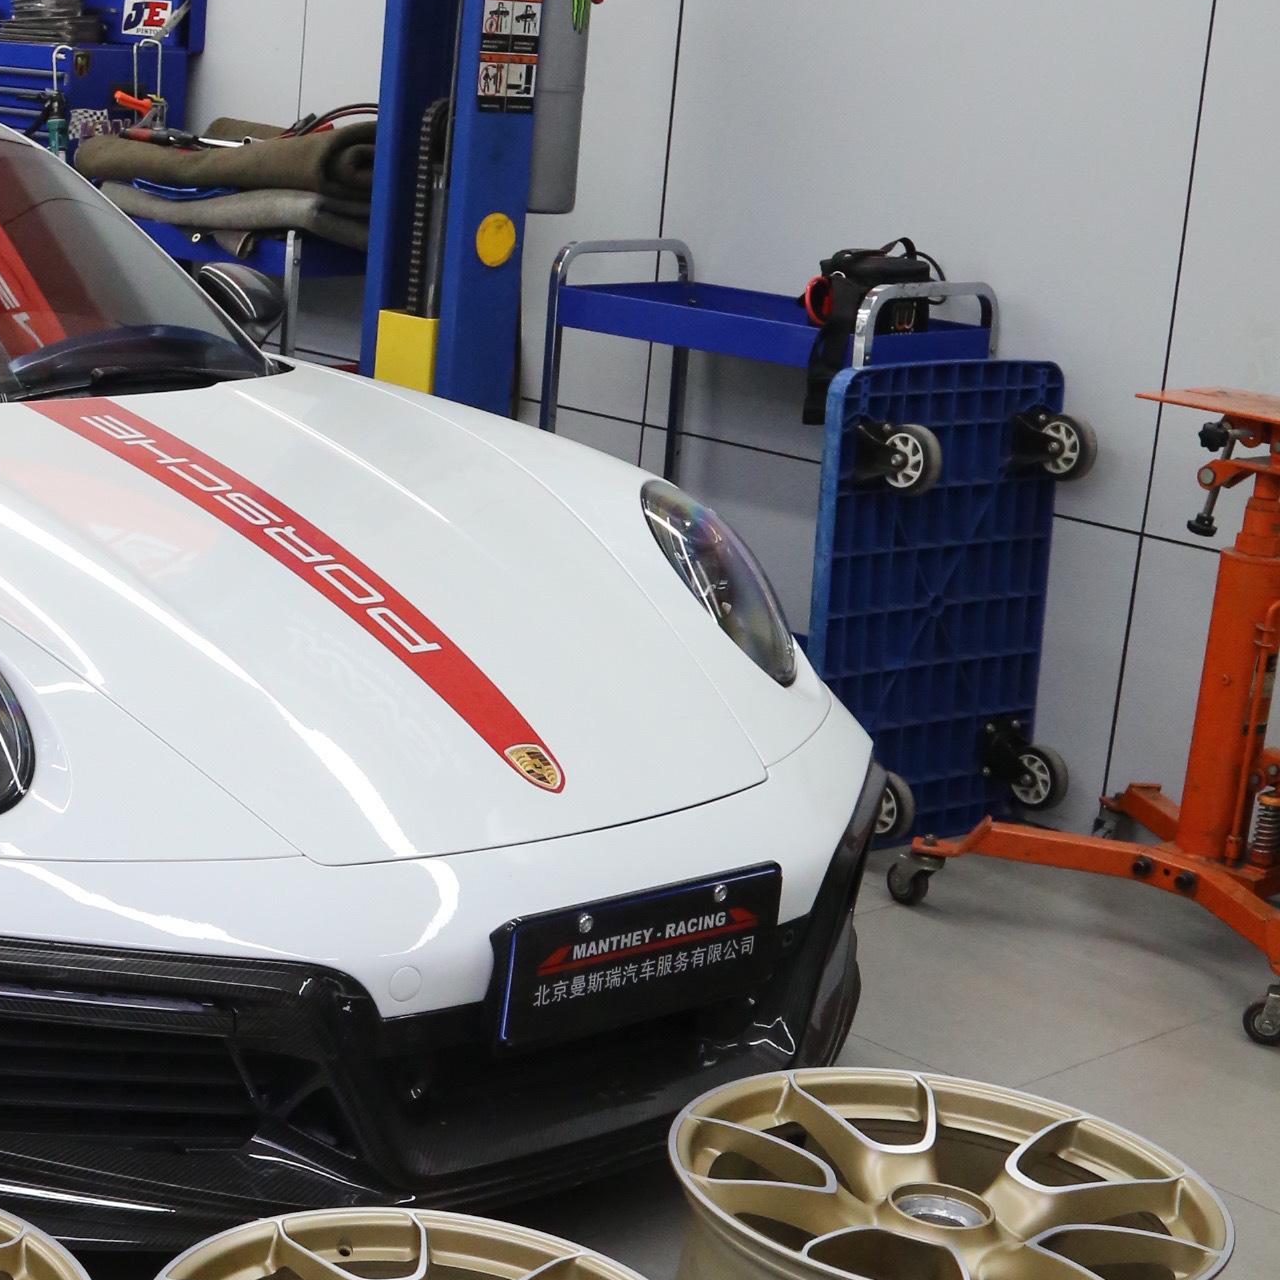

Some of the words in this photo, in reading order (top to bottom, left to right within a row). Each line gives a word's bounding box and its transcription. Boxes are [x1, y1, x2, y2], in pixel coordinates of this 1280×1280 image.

[123, 1, 168, 30] JE
[81, 414, 441, 654] PORSCHE
[572, 927, 654, 960] MANTHEY
[665, 911, 726, 939] RACING
[533, 935, 755, 1007] 北京曼斯瑞汽车服务有限公司
